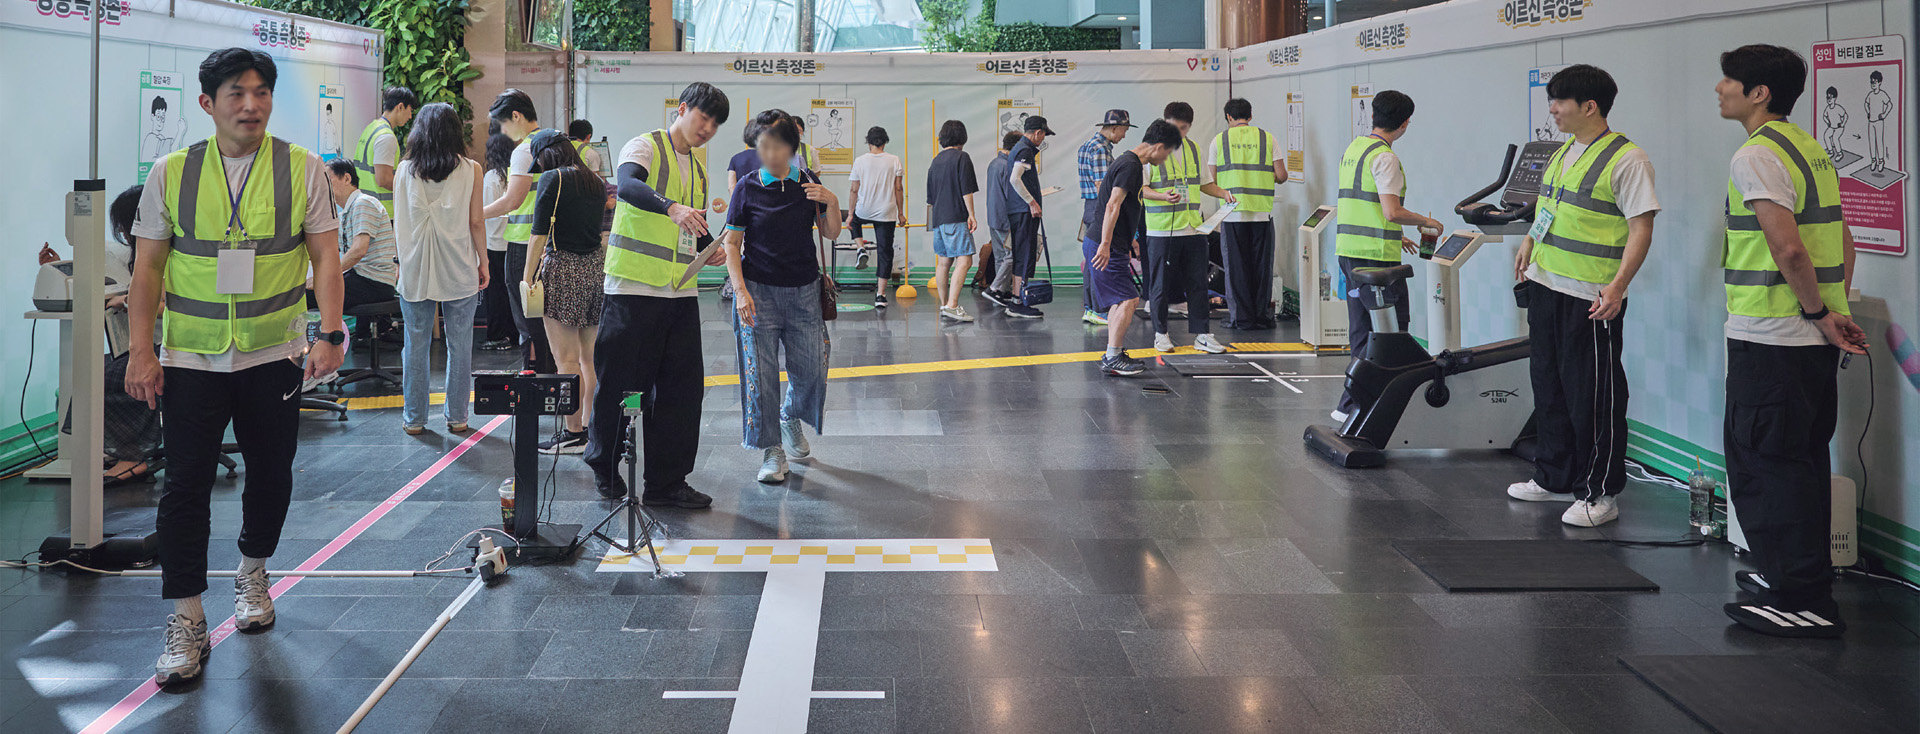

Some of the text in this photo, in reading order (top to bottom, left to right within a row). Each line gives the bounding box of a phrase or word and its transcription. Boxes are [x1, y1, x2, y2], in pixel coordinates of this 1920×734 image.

[1505, 0, 1541, 25] 어르신
[259, 19, 306, 48] 공통 측정존
[1360, 23, 1406, 48] 어르신 측정존
[1815, 44, 1884, 61] 성인 버티컬 점프
[733, 58, 816, 74] 어르신 측정존
[985, 58, 1068, 74] 어르신 측정존
